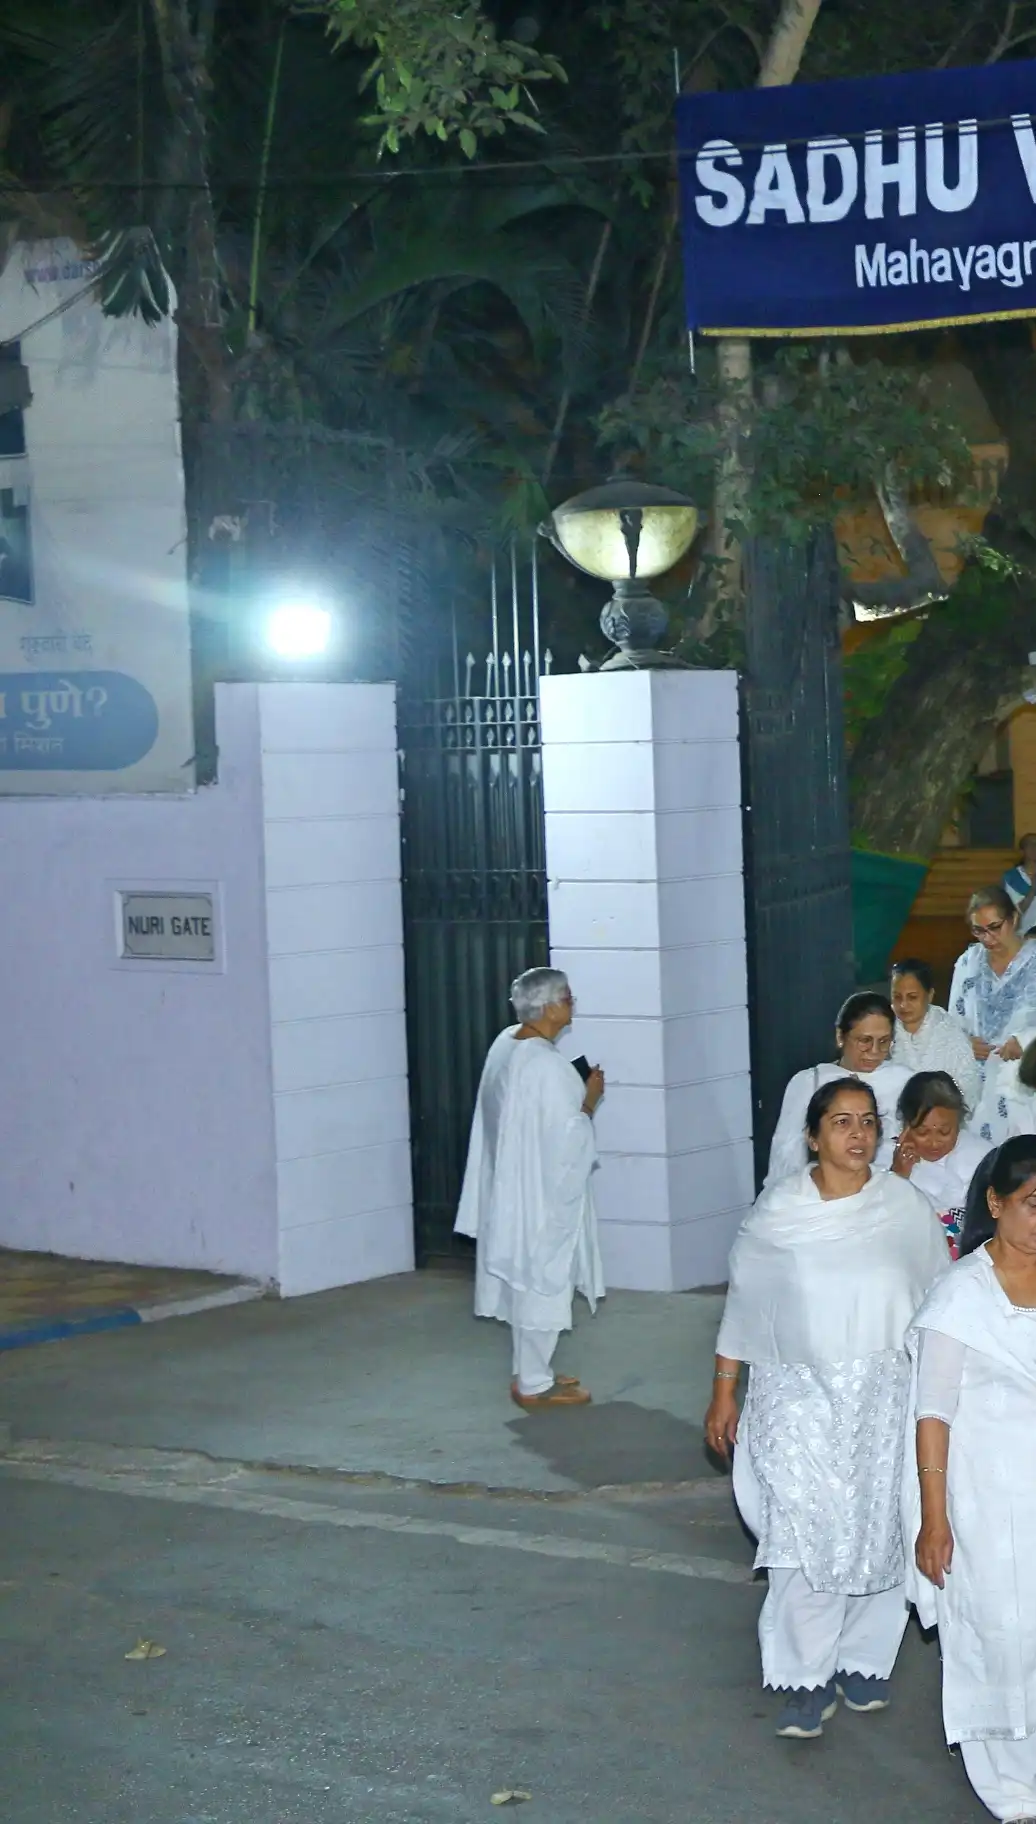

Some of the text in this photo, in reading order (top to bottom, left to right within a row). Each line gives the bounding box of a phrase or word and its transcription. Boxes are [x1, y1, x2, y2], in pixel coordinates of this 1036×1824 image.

[695, 118, 978, 227] SADHU
[20, 679, 108, 730] पुणे?
[127, 915, 212, 937] NURI GATE
